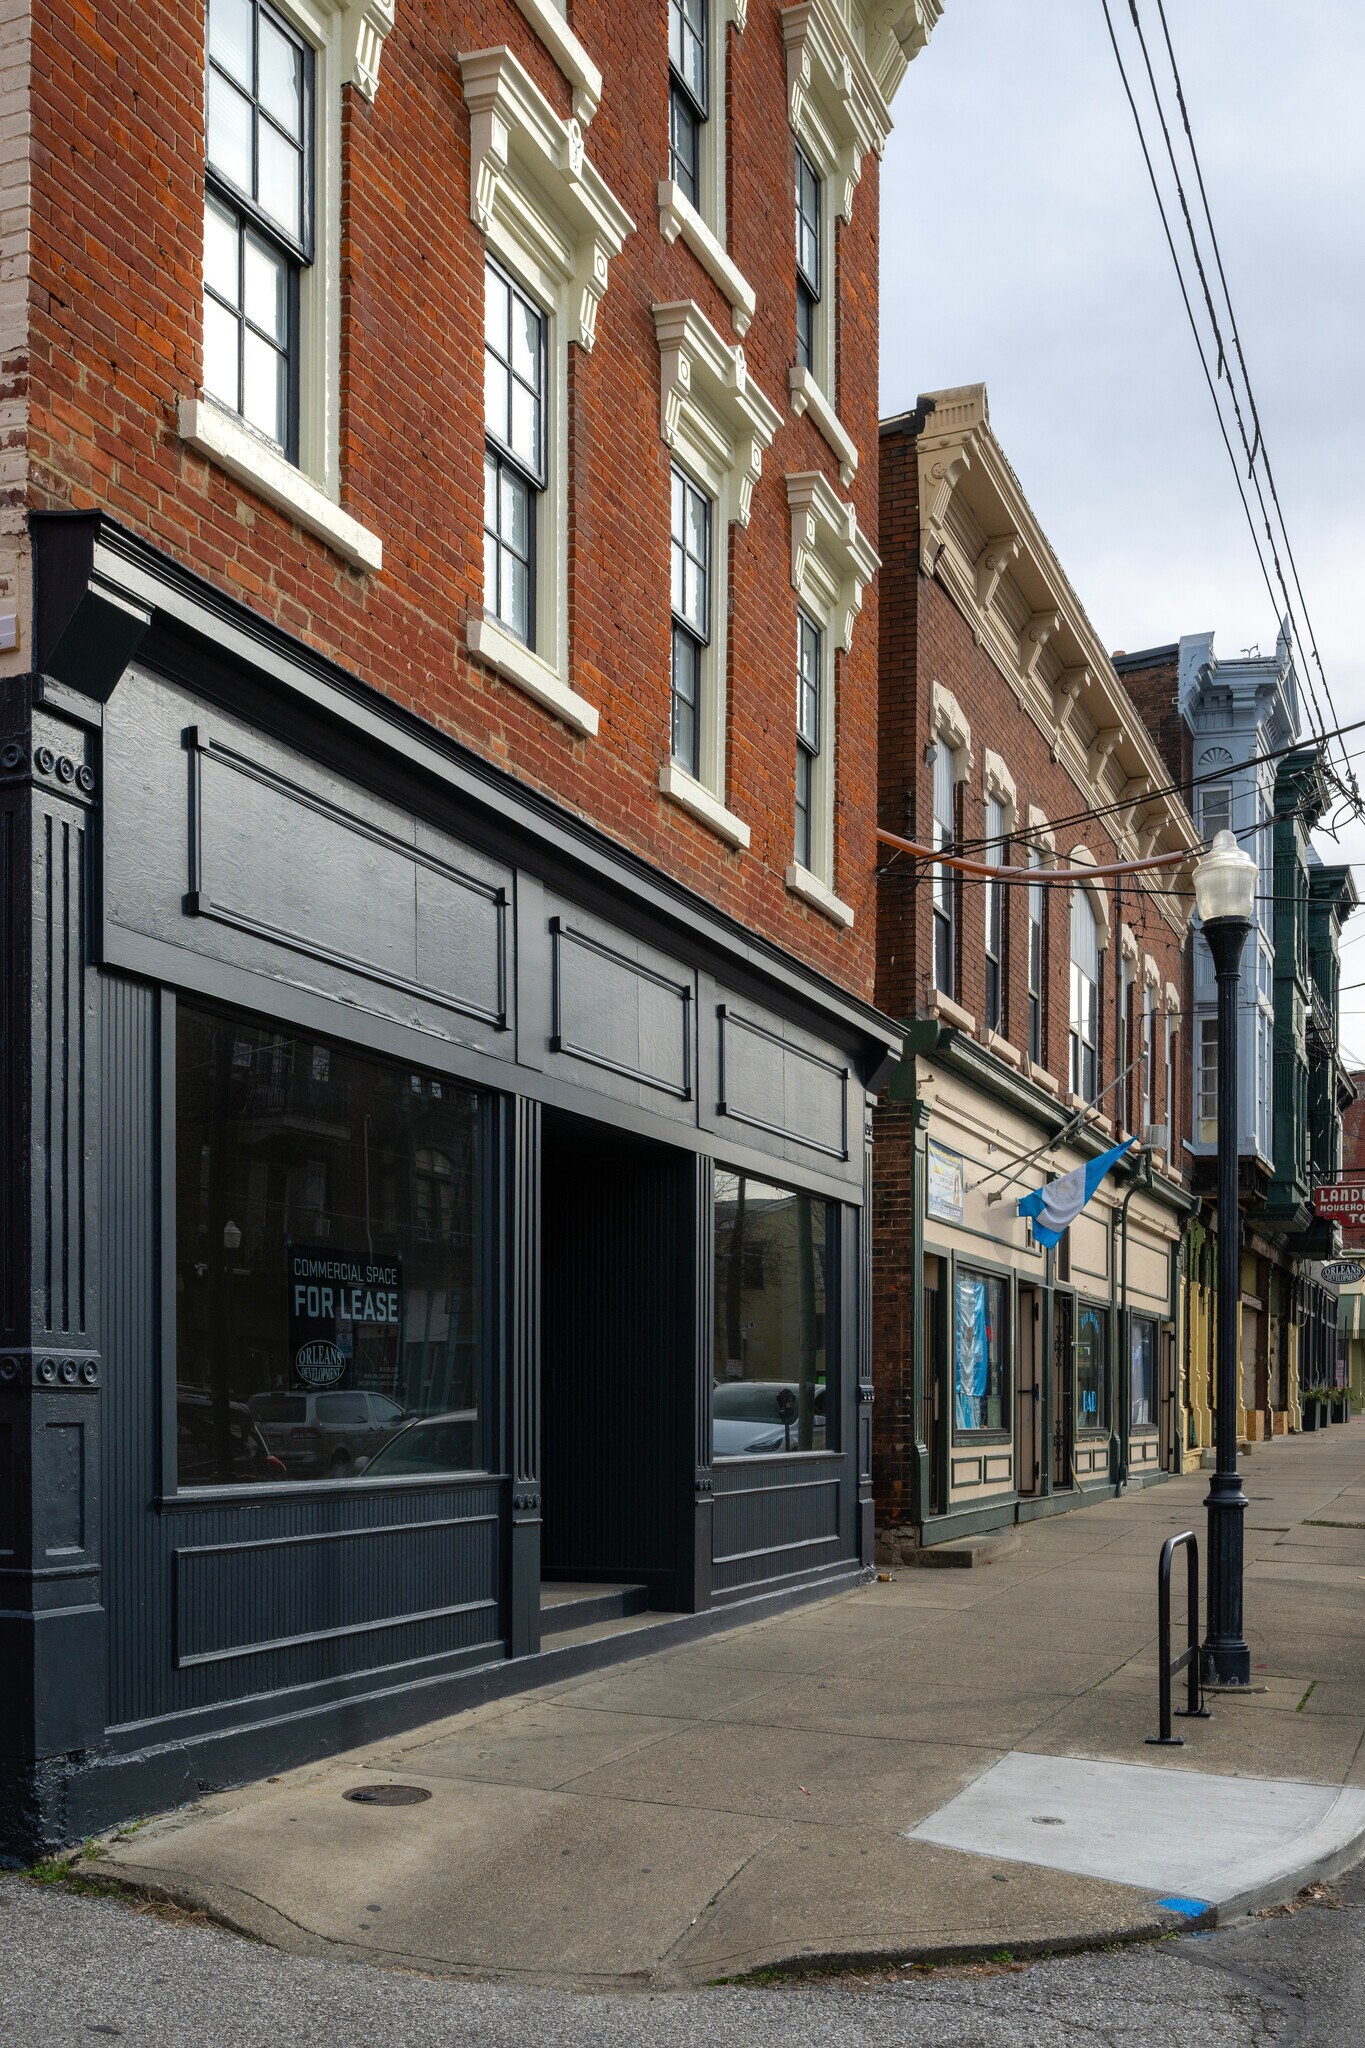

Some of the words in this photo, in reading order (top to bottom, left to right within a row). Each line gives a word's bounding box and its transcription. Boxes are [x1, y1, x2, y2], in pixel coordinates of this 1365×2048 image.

[294, 1258, 364, 1282] COMMERCIAL
[366, 1266, 397, 1285] SPACE
[1323, 1265, 1361, 1275] ORLEANS
[295, 1284, 335, 1318] FOR
[340, 1288, 398, 1323] LEASE
[299, 1345, 342, 1366] ORLEANS
[302, 1367, 340, 1382] DEVELOPMENT
[1083, 1390, 1096, 1412] BAR
